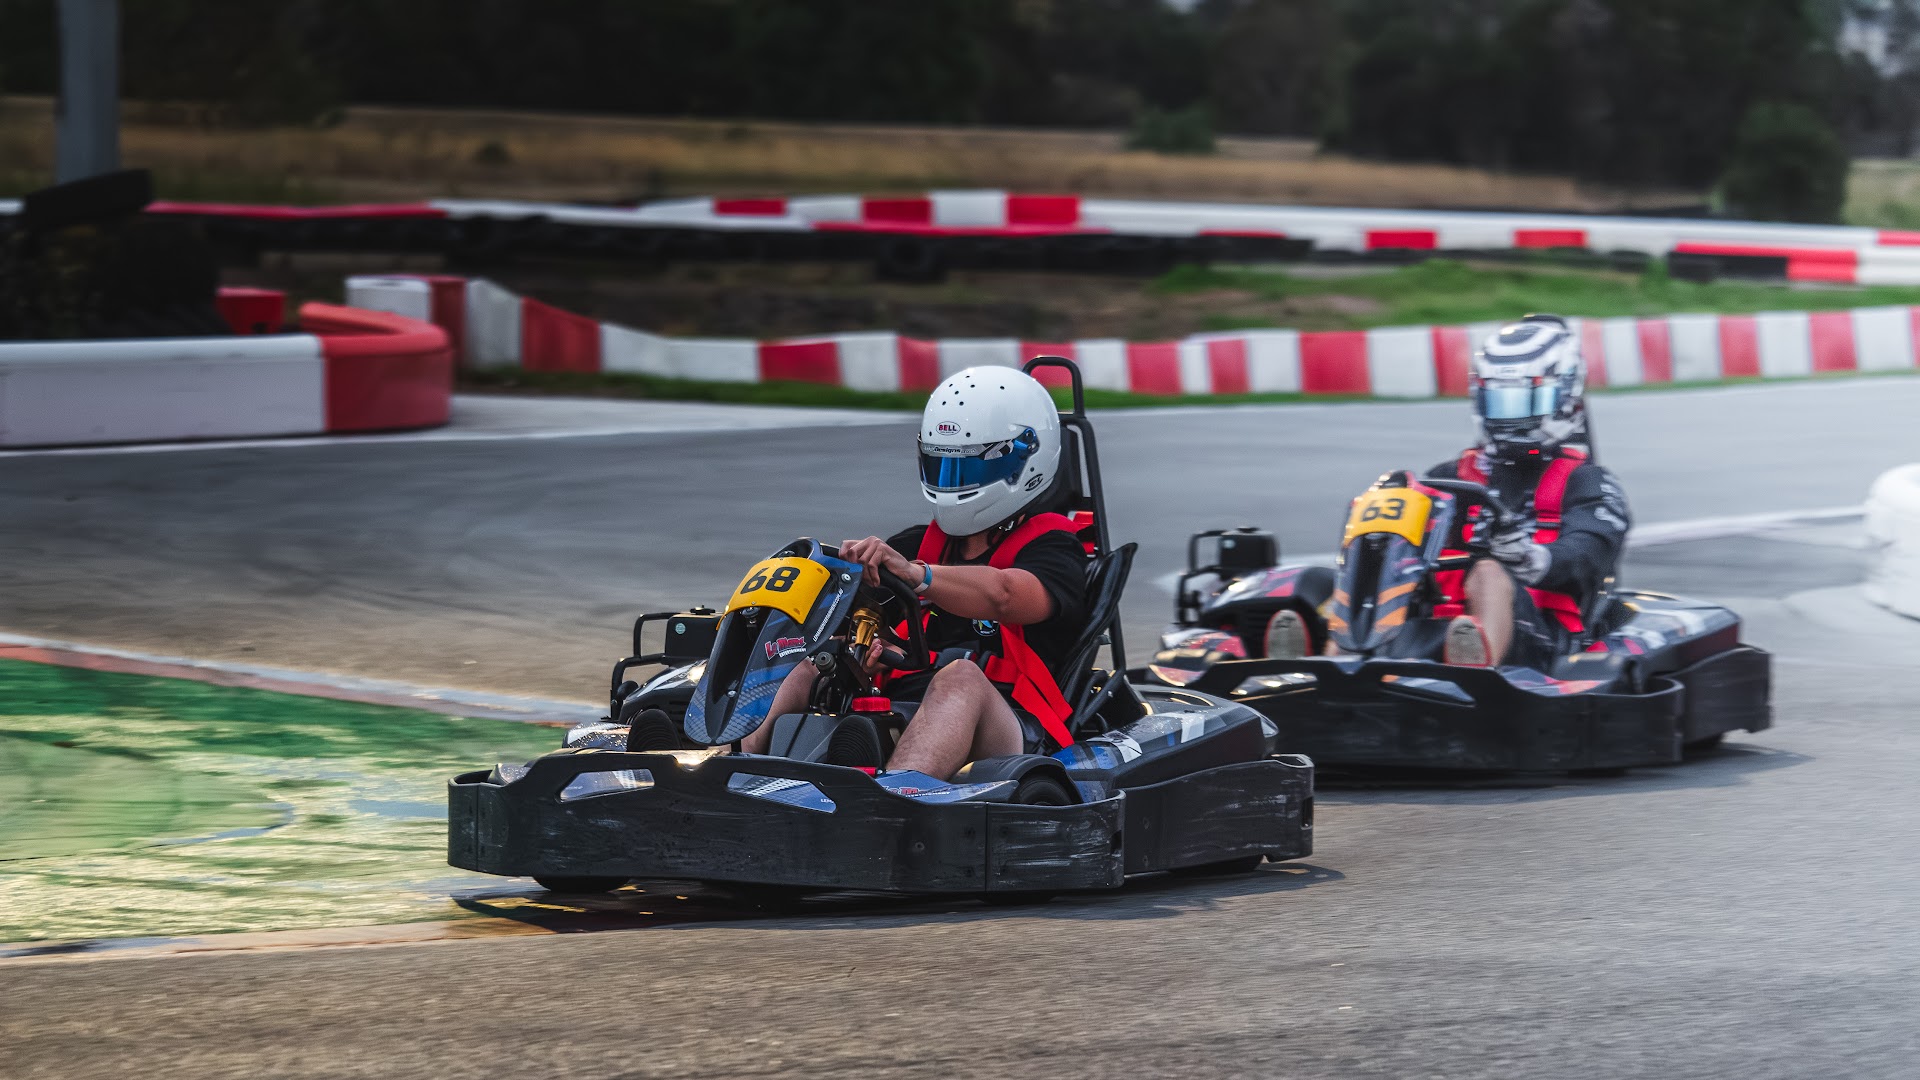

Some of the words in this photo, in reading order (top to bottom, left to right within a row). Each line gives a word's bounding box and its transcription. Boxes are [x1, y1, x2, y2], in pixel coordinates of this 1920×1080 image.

[938, 424, 957, 432] BELL
[1360, 498, 1406, 522] 63
[740, 566, 801, 595] 68
